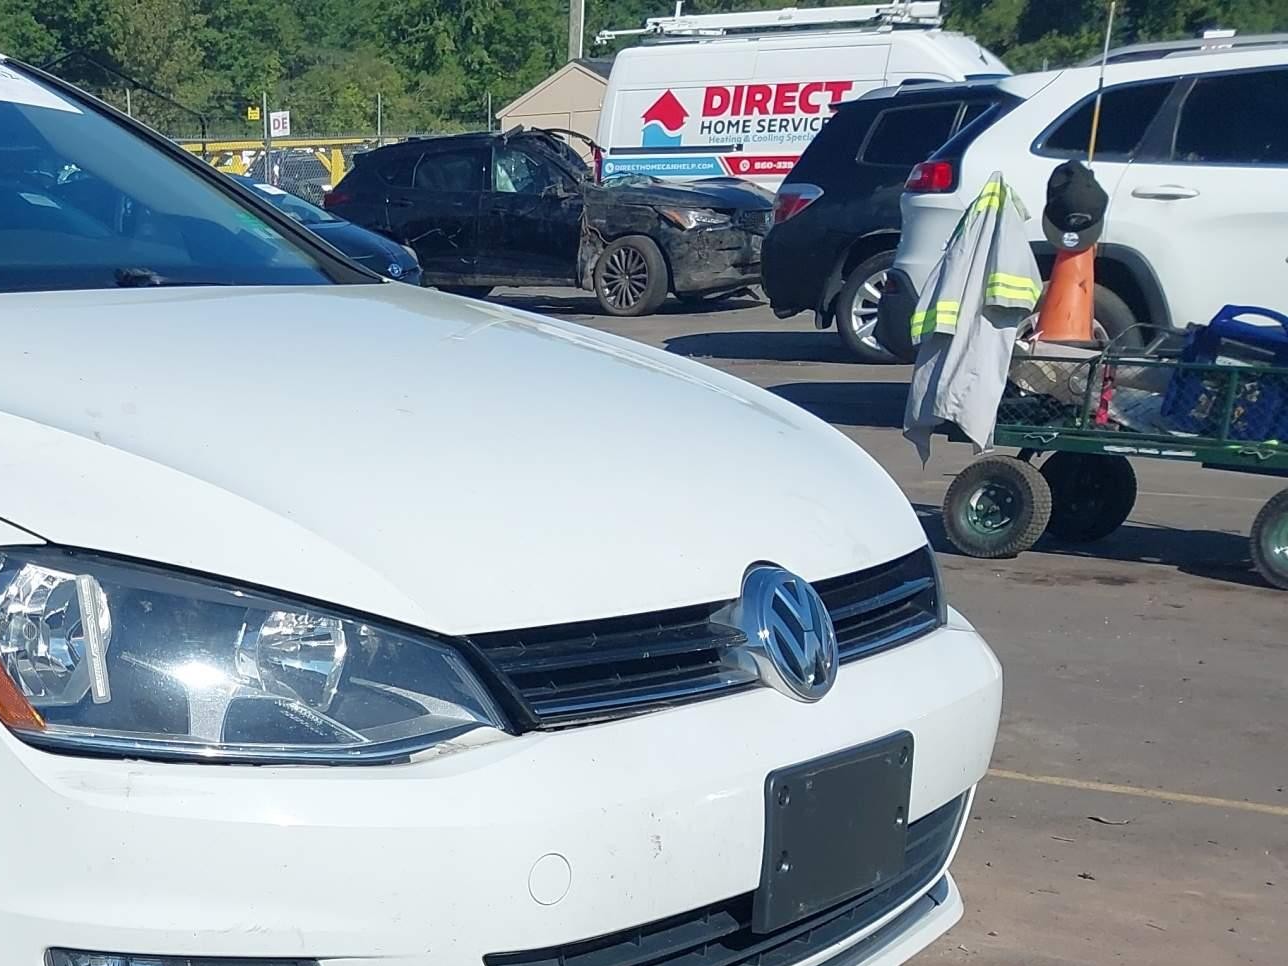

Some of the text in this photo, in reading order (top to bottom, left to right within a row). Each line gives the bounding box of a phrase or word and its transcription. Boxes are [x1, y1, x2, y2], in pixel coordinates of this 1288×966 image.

[702, 80, 854, 117] DIRECT
[700, 119, 752, 135] HOME
[709, 133, 742, 144] Heating
[743, 134, 751, 142] &
[752, 132, 785, 144] Cooling
